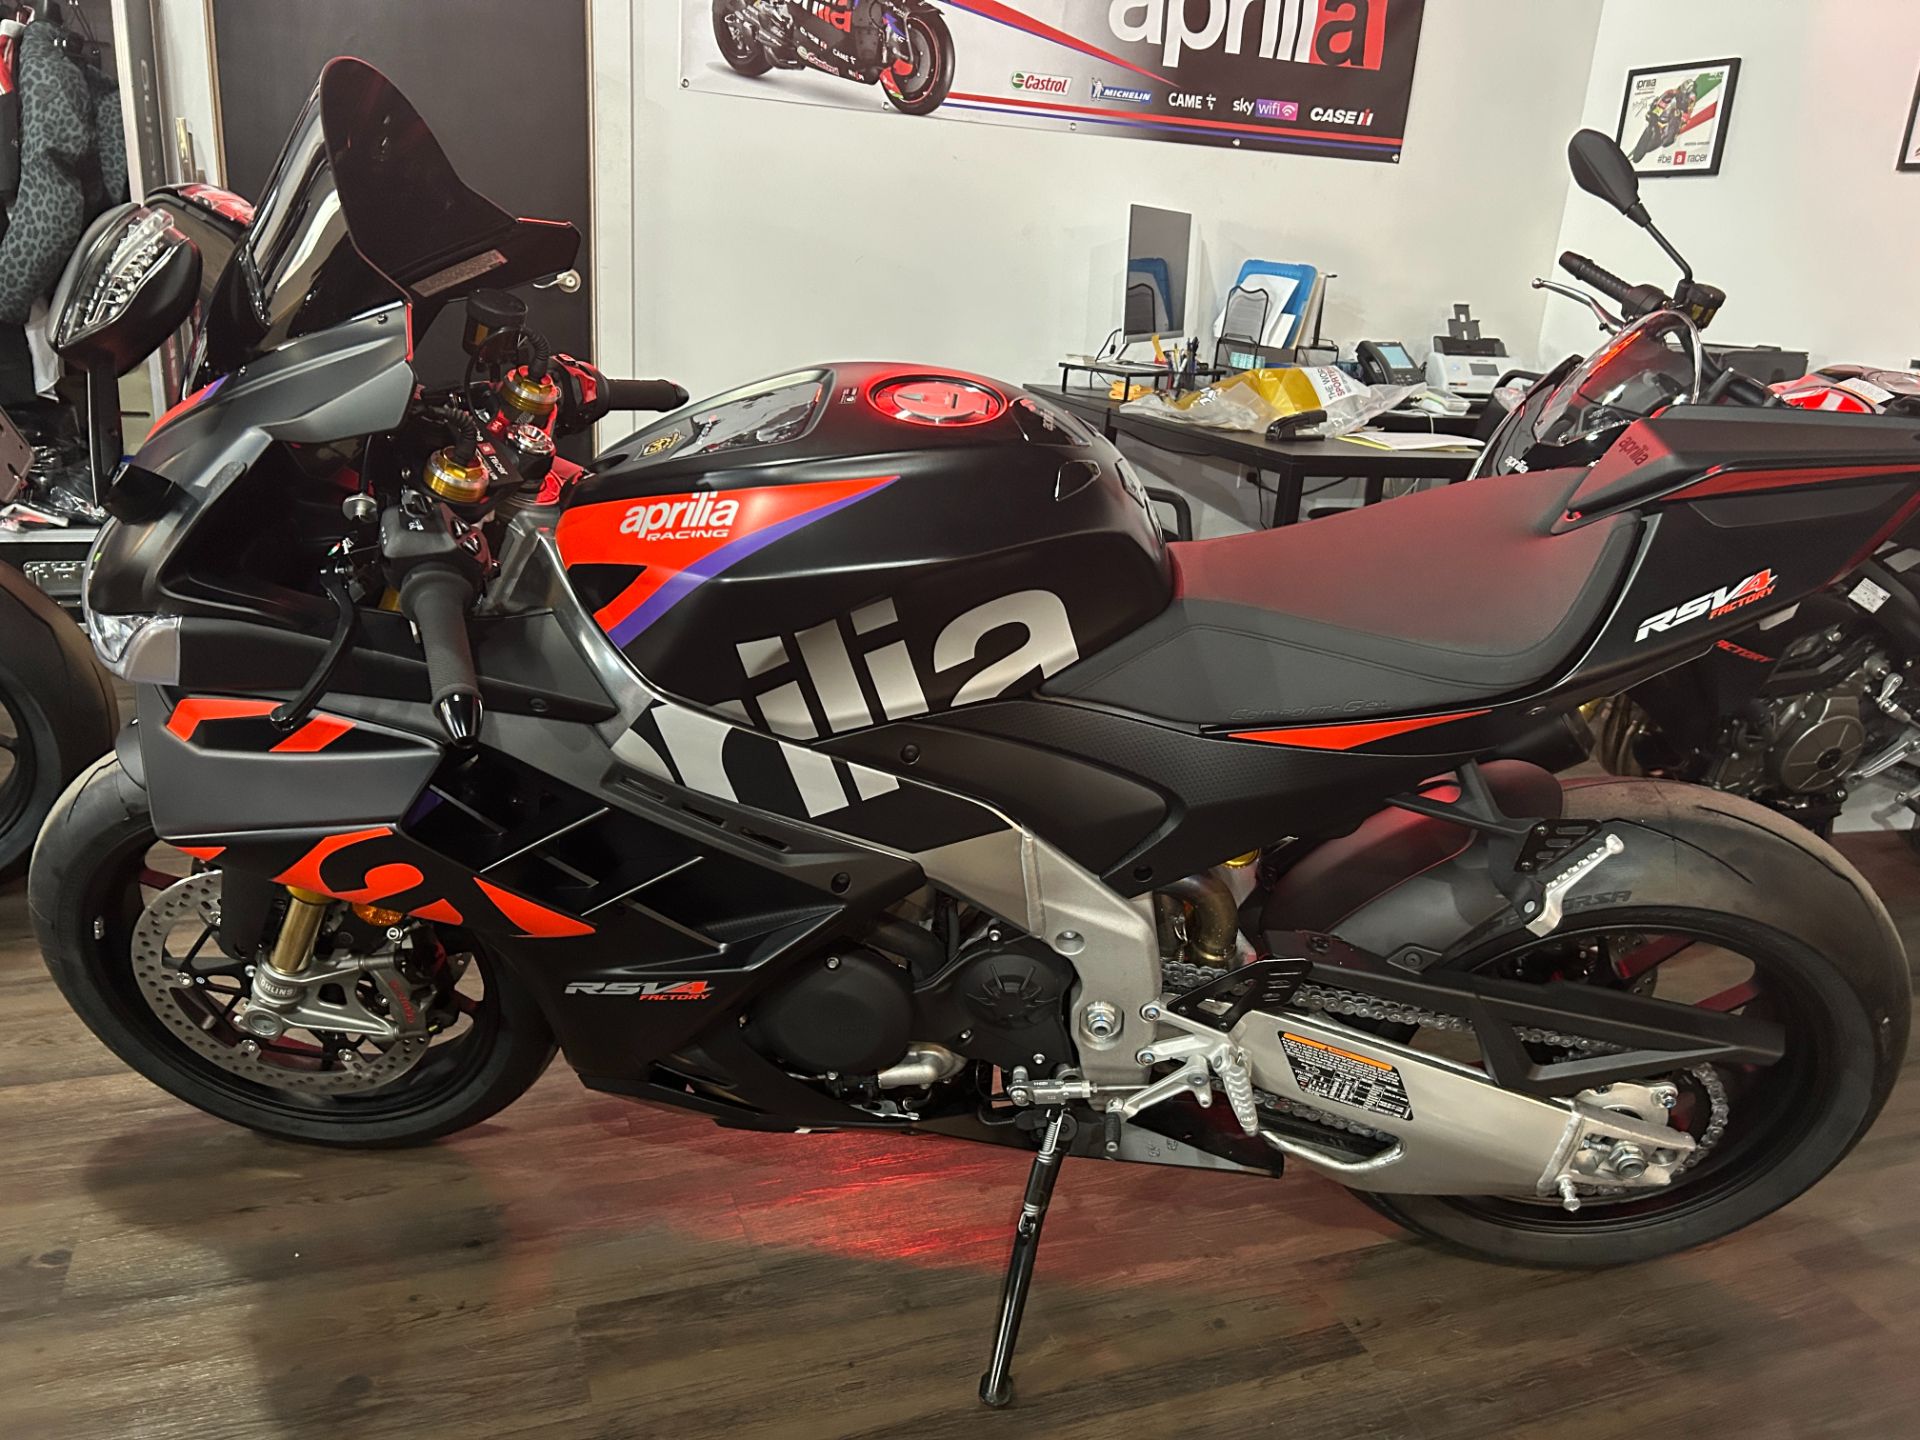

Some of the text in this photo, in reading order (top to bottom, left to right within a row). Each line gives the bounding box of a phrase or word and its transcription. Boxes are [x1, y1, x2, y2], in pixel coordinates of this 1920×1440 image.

[1024, 75, 1068, 93] Castrol
[1103, 88, 1151, 100] MICHELIN
[1168, 92, 1203, 109] CAME
[1233, 97, 1280, 116] sky wifi
[1310, 107, 1357, 125] CASE
[1619, 436, 1649, 466] aprilia
[488, 456, 508, 475] racer
[619, 491, 740, 538] aprilia
[646, 528, 729, 541] RACING
[1635, 568, 1778, 642] RSV4
[1709, 585, 1776, 620] FACTORY
[564, 980, 715, 995] RSV4
[639, 993, 711, 1001] FACTORY
